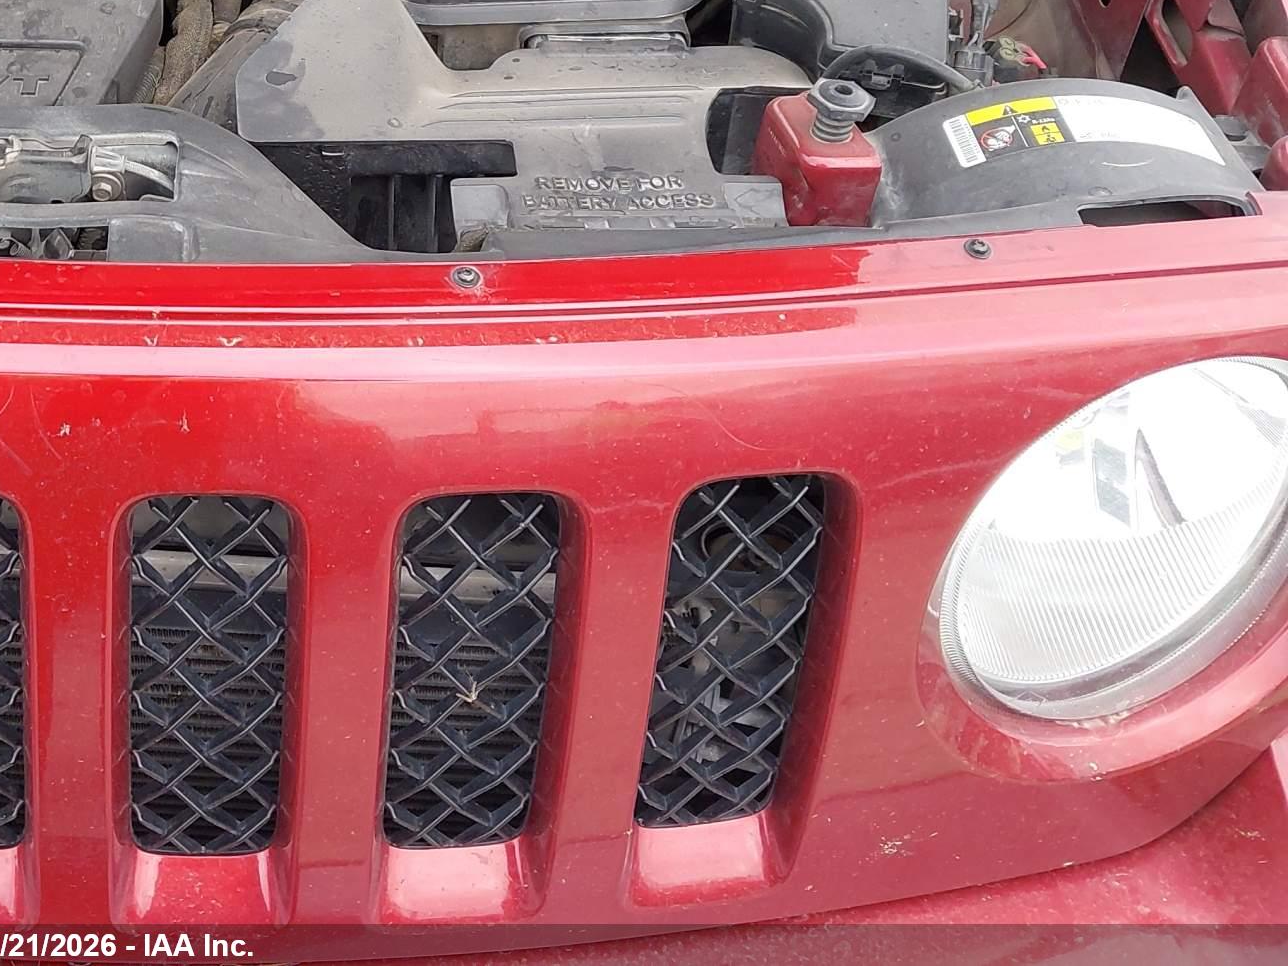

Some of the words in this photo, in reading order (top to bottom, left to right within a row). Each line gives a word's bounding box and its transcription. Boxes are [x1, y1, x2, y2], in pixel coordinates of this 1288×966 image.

[534, 175, 632, 192] REMOVE
[636, 174, 685, 191] FOR
[521, 193, 617, 211] BATTERY
[626, 191, 715, 210] ACCESS
